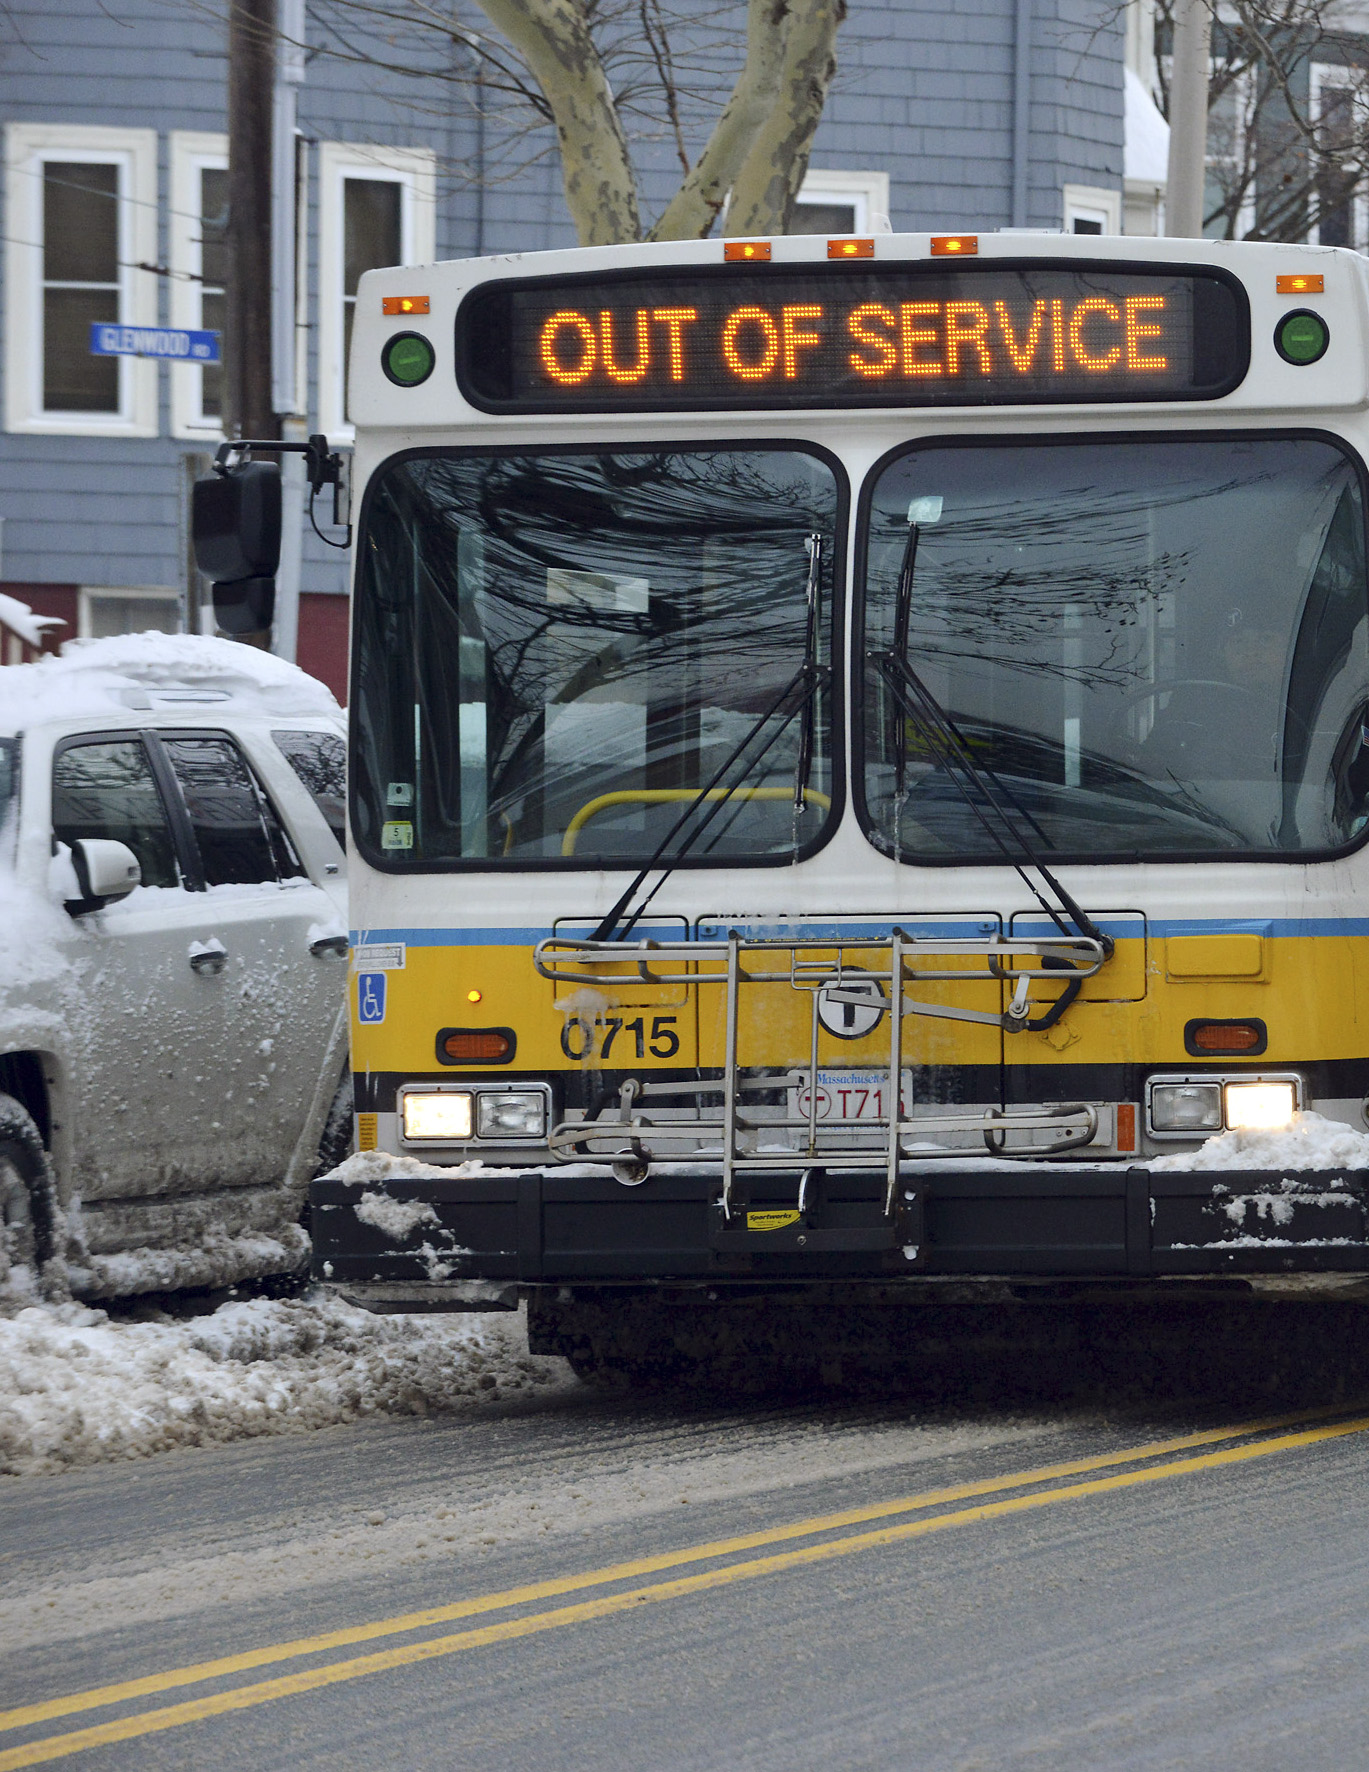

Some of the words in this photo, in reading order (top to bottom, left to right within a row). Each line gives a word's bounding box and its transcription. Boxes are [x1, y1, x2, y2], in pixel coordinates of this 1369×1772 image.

[101, 328, 190, 356] GLENWOOD
[540, 309, 696, 382] OUT
[723, 306, 822, 378] OF
[848, 297, 1167, 377] SERVICE
[393, 827, 399, 837] 5
[560, 1016, 680, 1060] 0715
[749, 1212, 793, 1222] Sportworks
